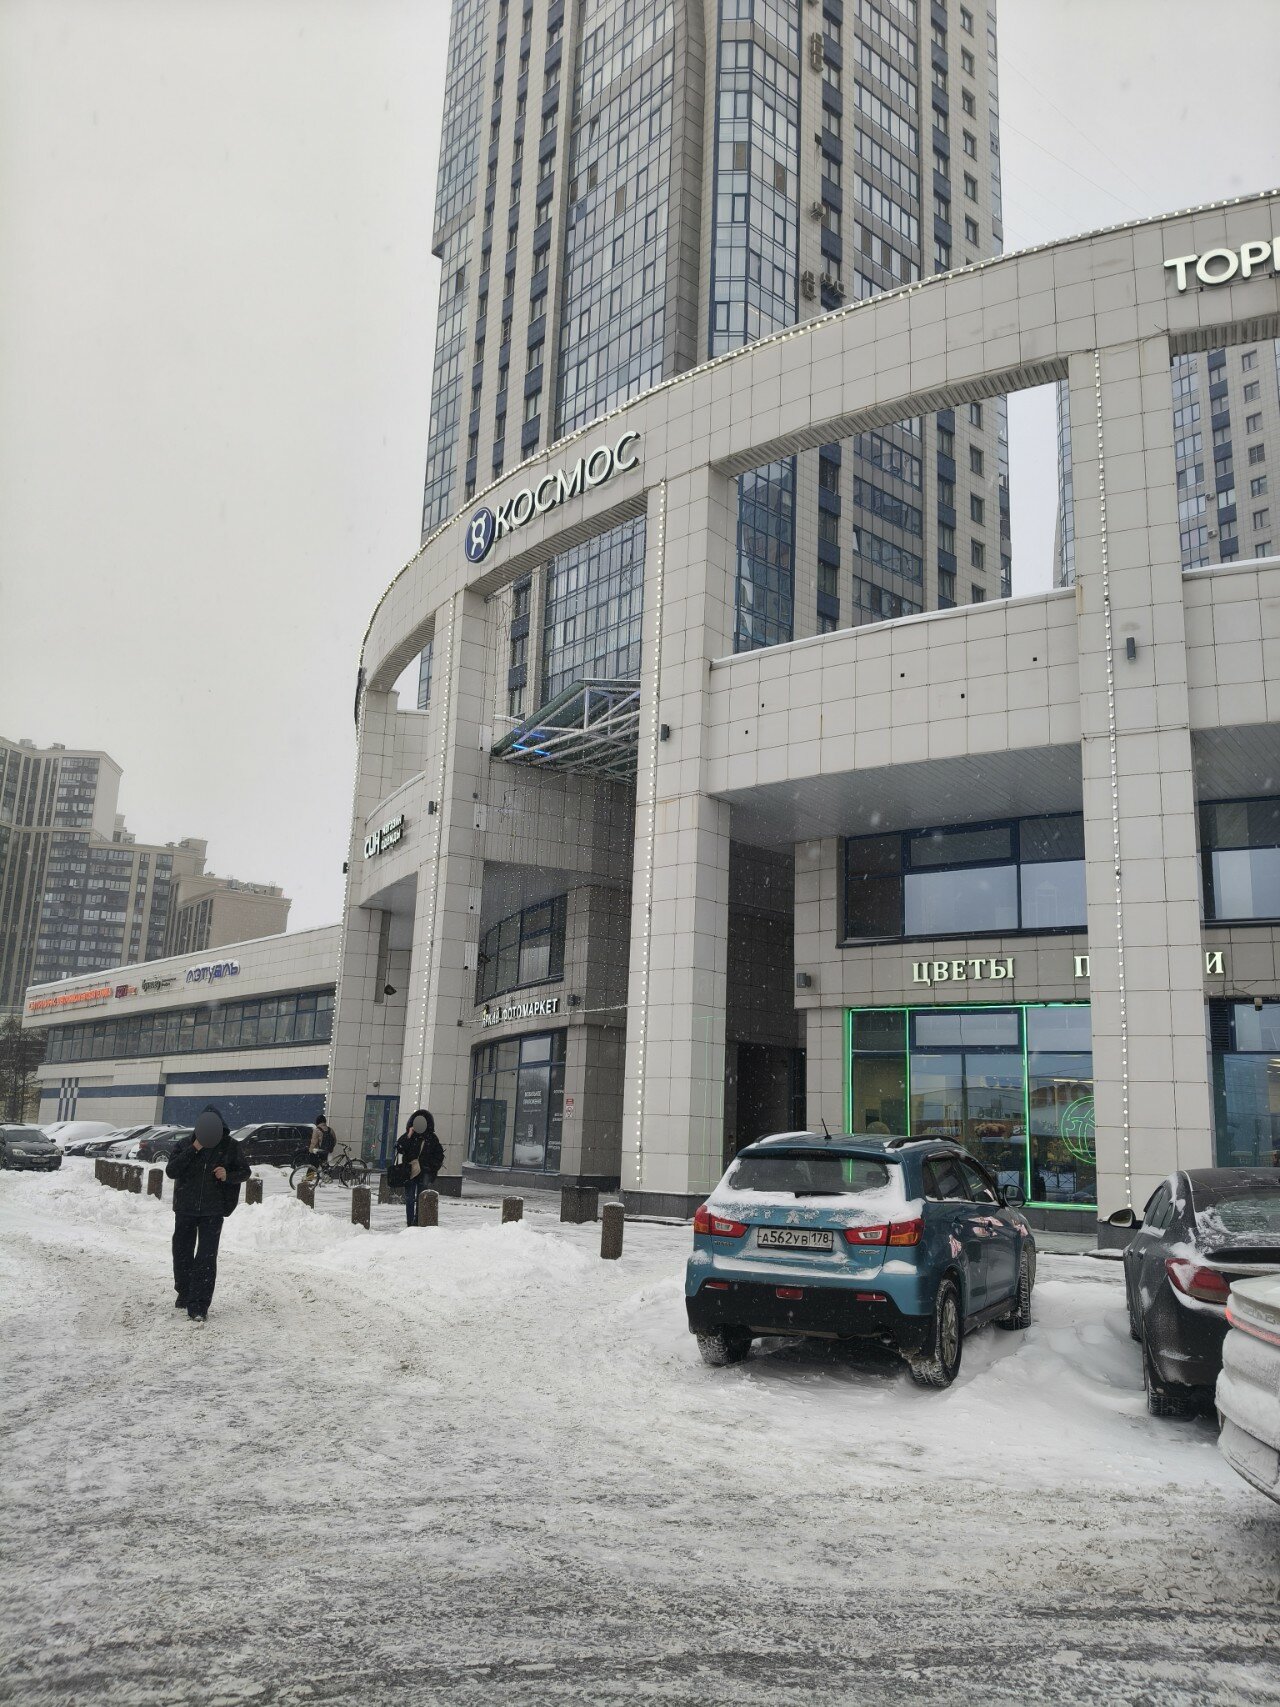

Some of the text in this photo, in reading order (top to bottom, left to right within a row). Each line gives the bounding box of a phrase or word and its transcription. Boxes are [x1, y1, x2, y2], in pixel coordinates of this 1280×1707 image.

[1163, 236, 1280, 292] ТОР
[494, 430, 640, 540] КОСМОС
[912, 957, 1015, 987] ЦВЕТЫ
[501, 998, 559, 1022] ФОТОМАРКЕТ
[811, 1232, 830, 1244] 178
